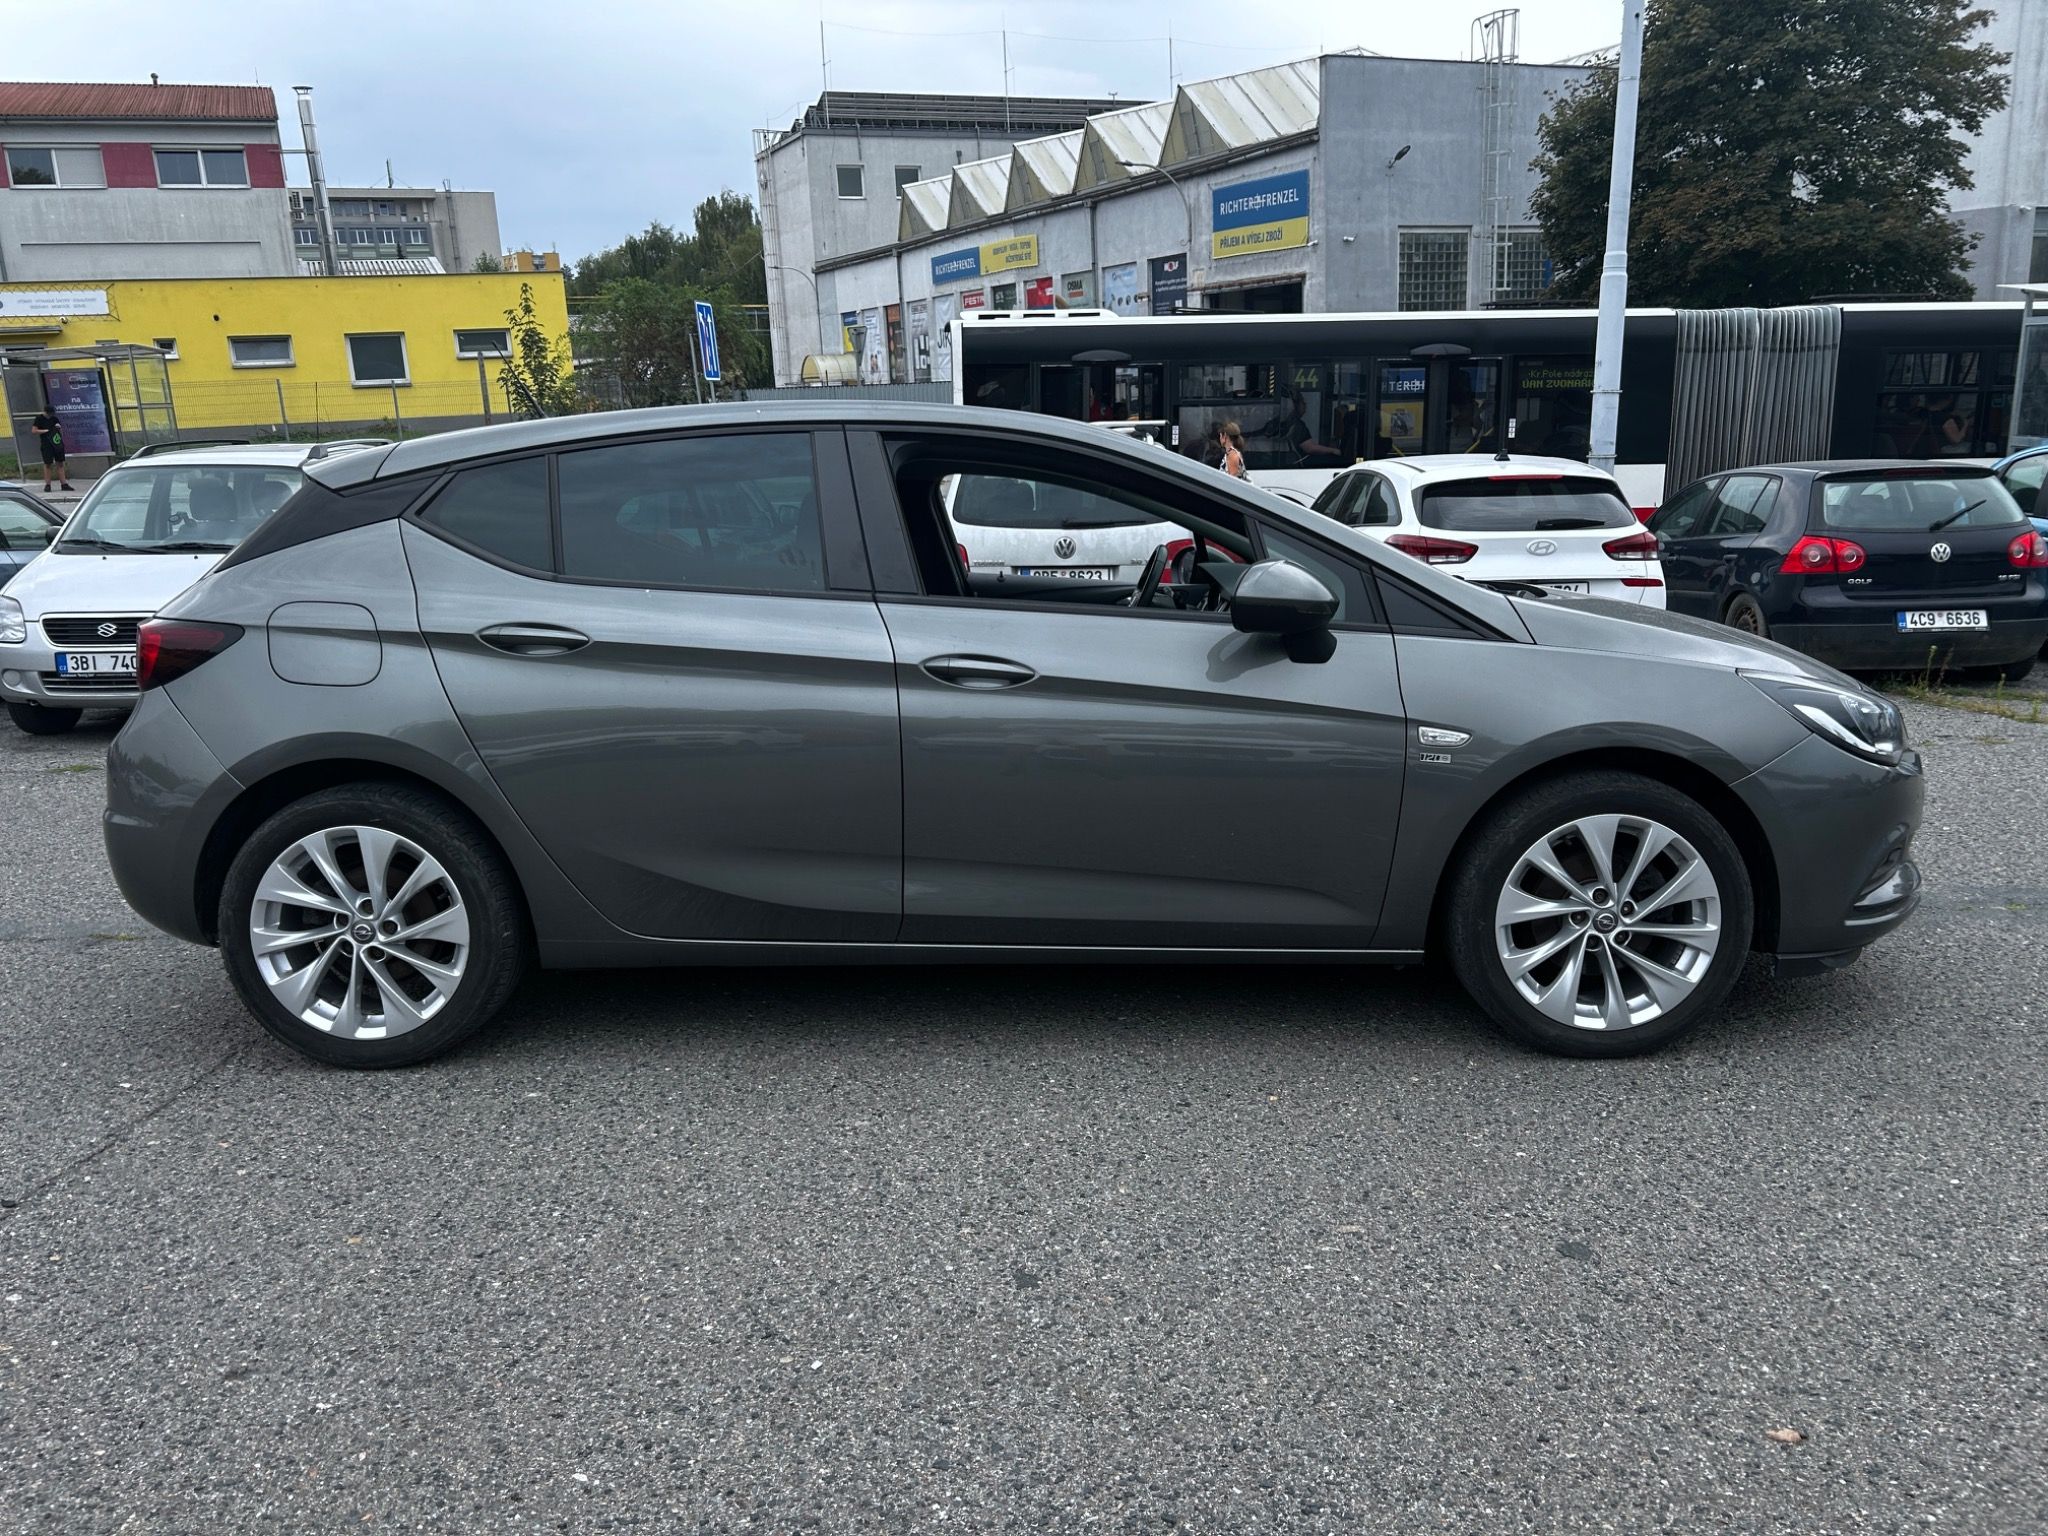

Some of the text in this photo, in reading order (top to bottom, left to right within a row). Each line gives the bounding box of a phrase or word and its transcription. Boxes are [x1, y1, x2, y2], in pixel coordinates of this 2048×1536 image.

[1294, 367, 1319, 389] 44
[1910, 613, 1936, 627] 4C9
[1946, 612, 1981, 625] 6636
[70, 655, 97, 671] 3BI
[110, 655, 137, 671] 740
